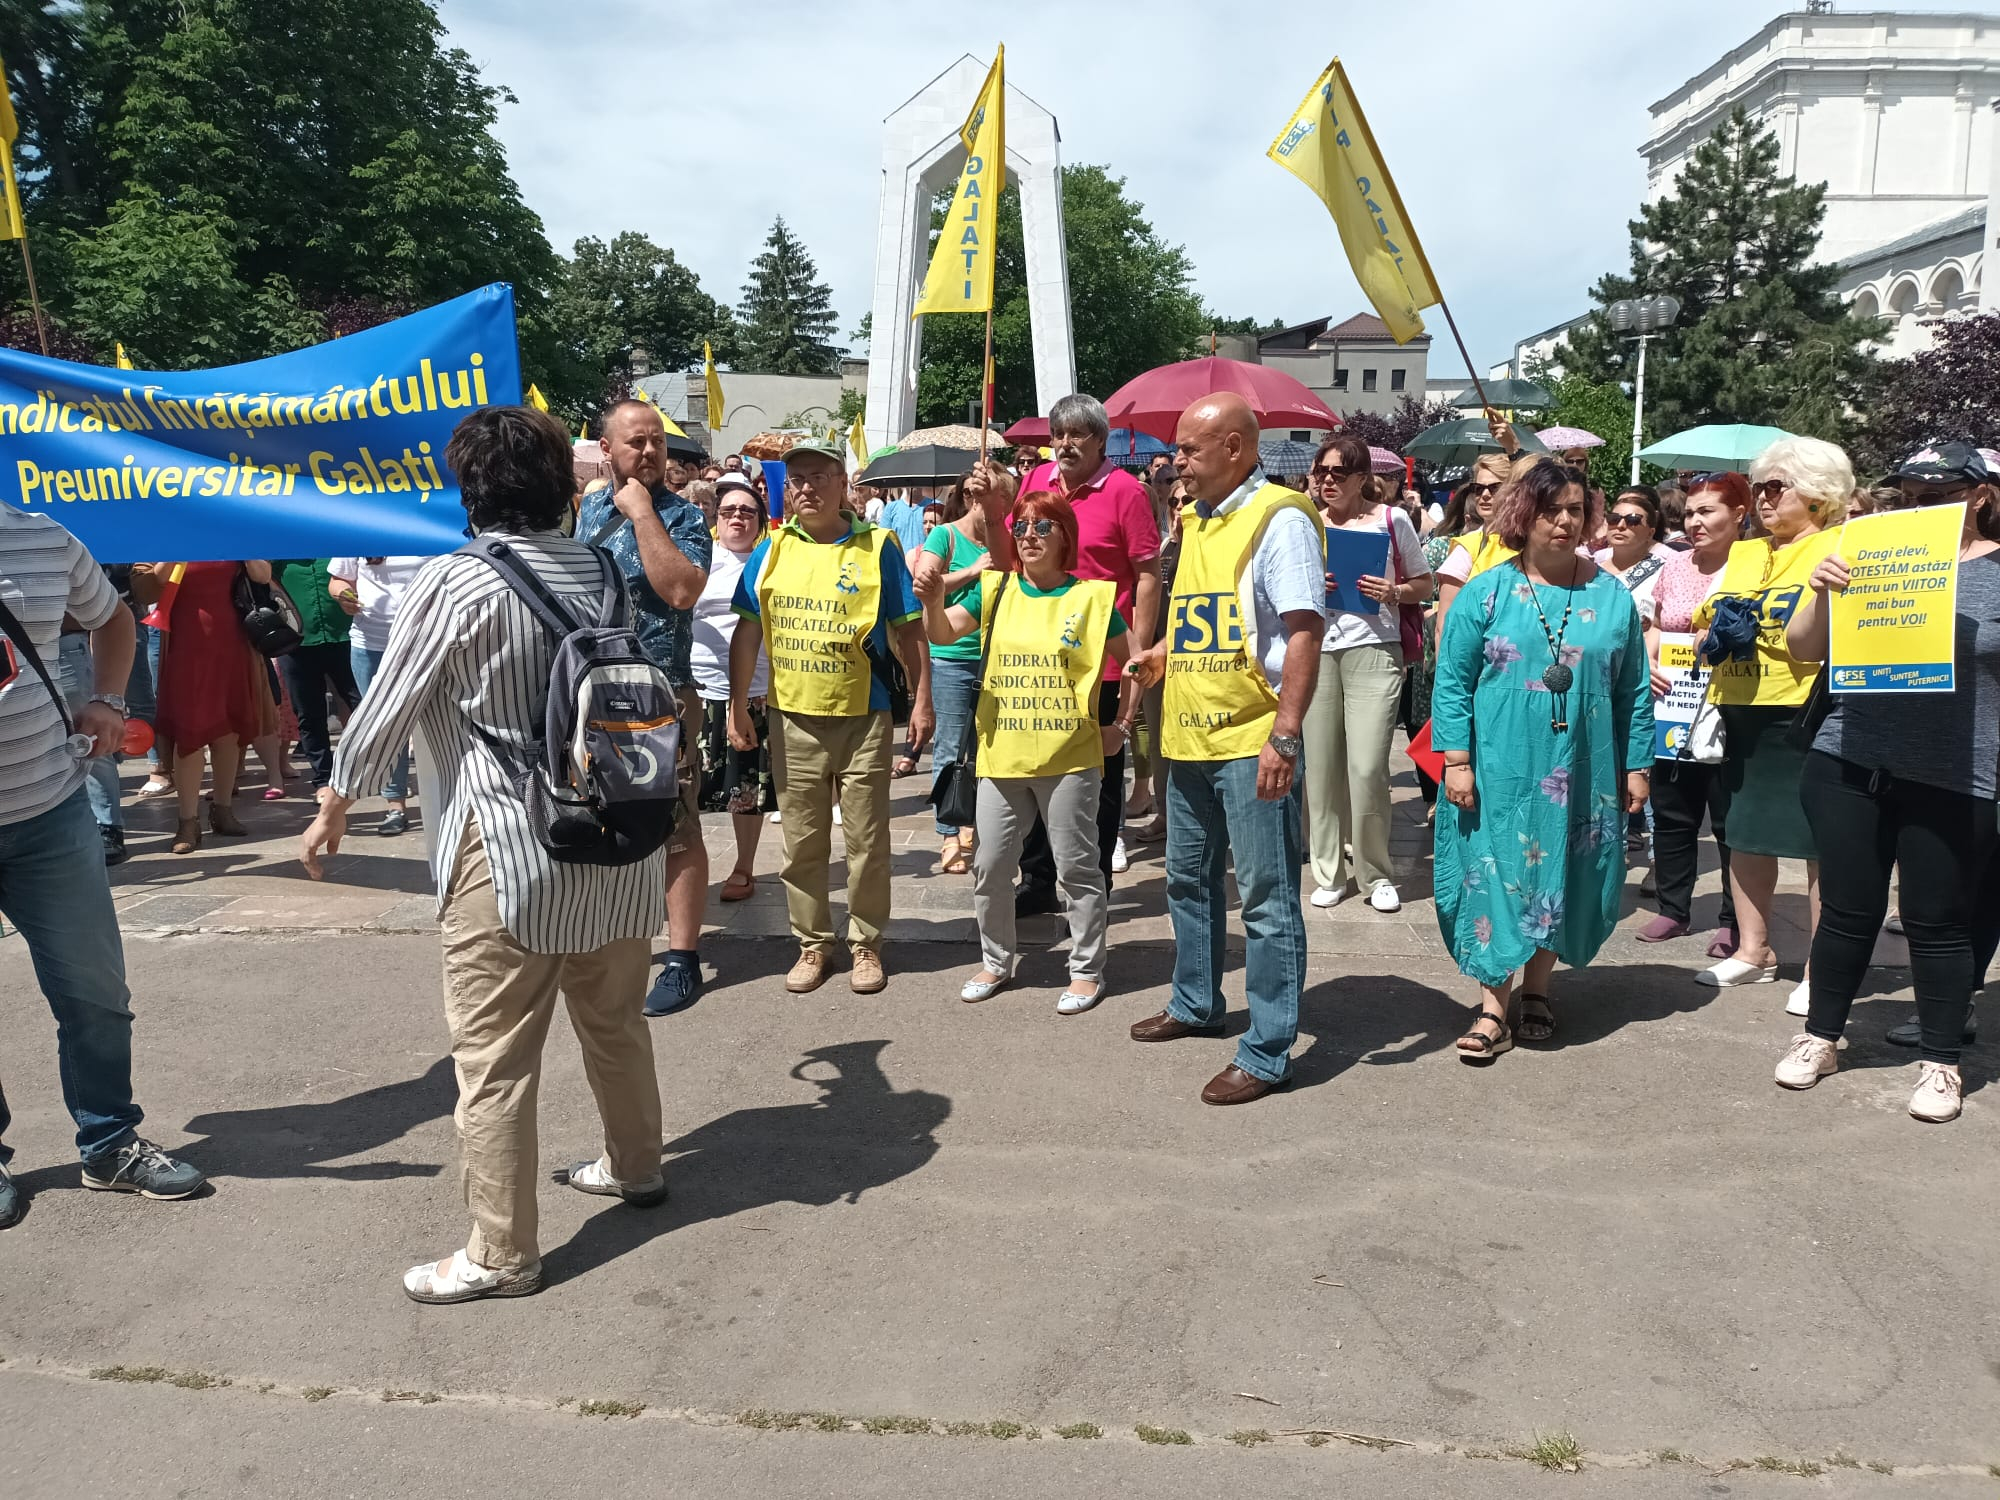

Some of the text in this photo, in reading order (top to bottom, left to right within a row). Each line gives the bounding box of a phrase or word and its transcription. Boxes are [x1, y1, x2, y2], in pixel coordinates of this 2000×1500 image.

[17, 441, 444, 504] Preuniversitar Galați
[1857, 544, 1929, 561] Dragi elevi,
[1850, 559, 1953, 579] OTESTĂM astăzi
[1841, 577, 1947, 598] pentru un VIITOR
[1866, 597, 1915, 610] mai bun
[1858, 613, 1928, 630] pentru VOI!
